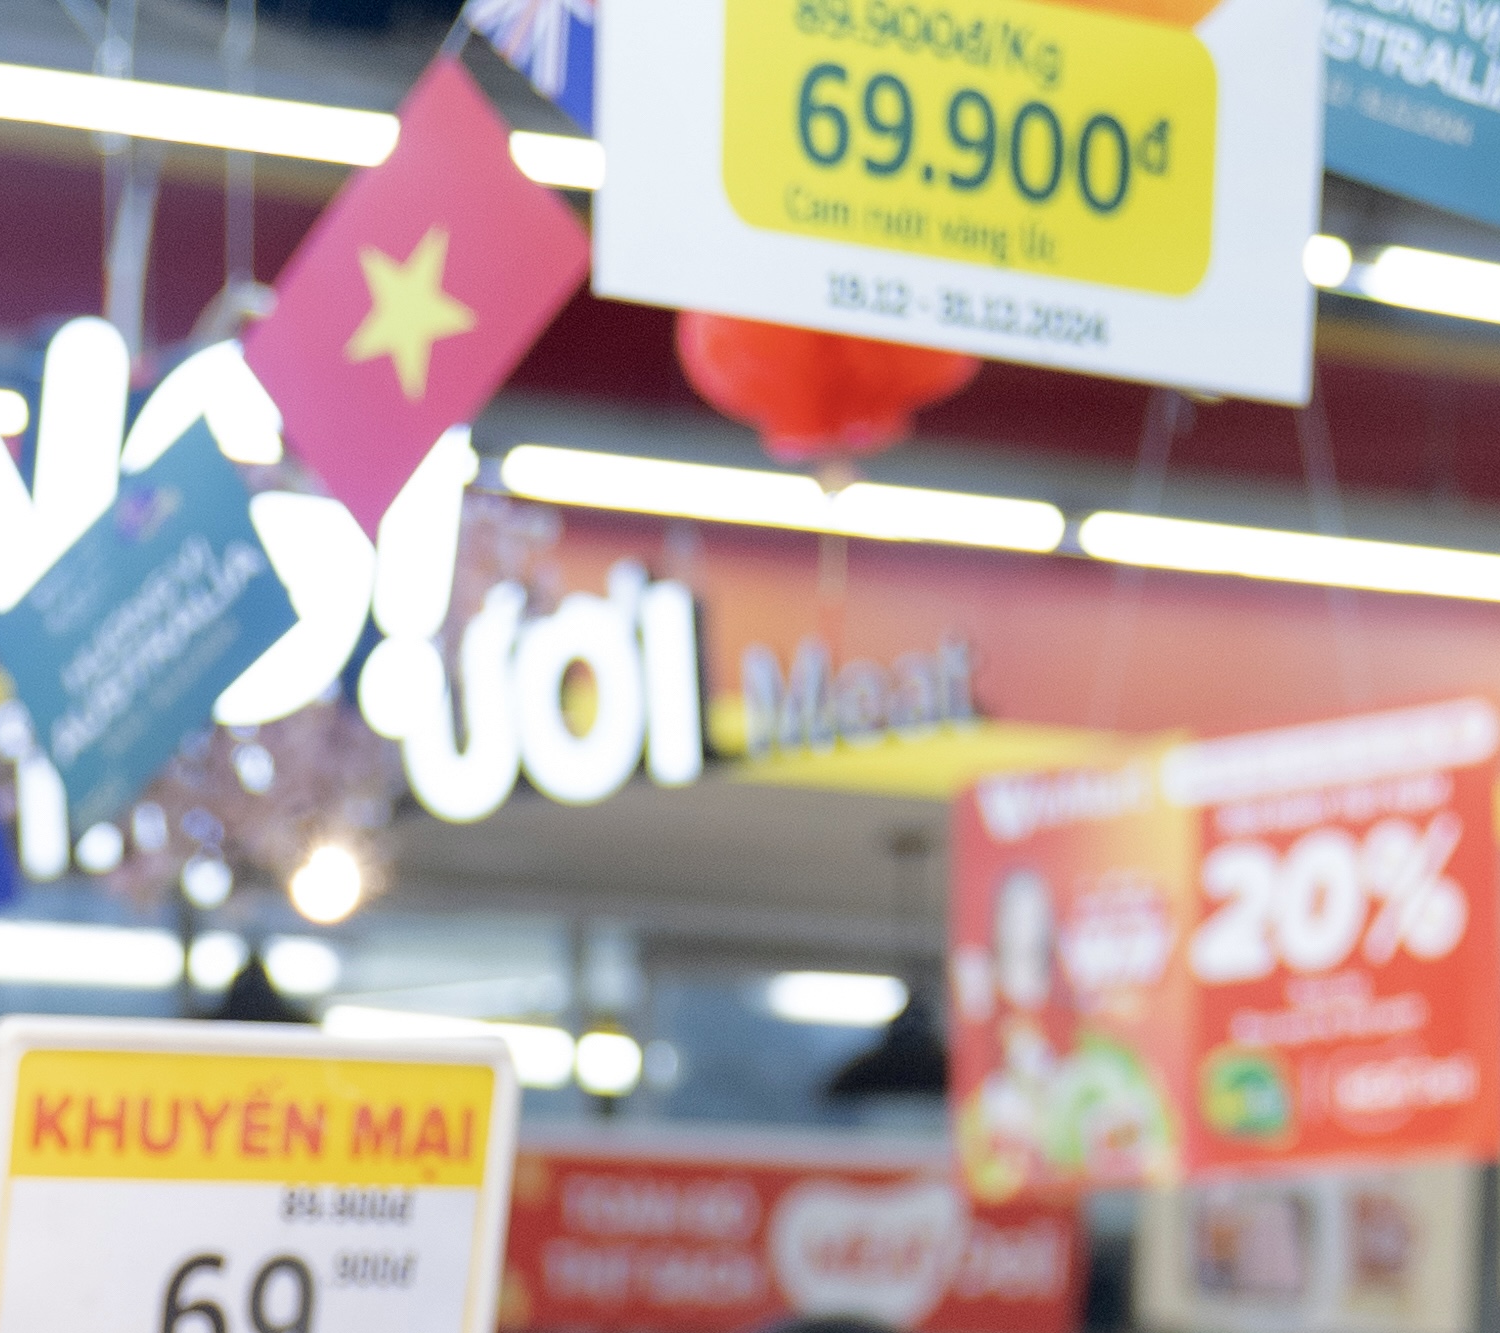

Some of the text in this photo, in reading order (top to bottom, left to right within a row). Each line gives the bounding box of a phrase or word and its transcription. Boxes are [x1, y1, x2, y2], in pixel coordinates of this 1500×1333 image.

[797, 60, 1173, 216] 69.900đ
[1190, 812, 1470, 986] 20%
[28, 1076, 328, 1165] KHUYẾN
